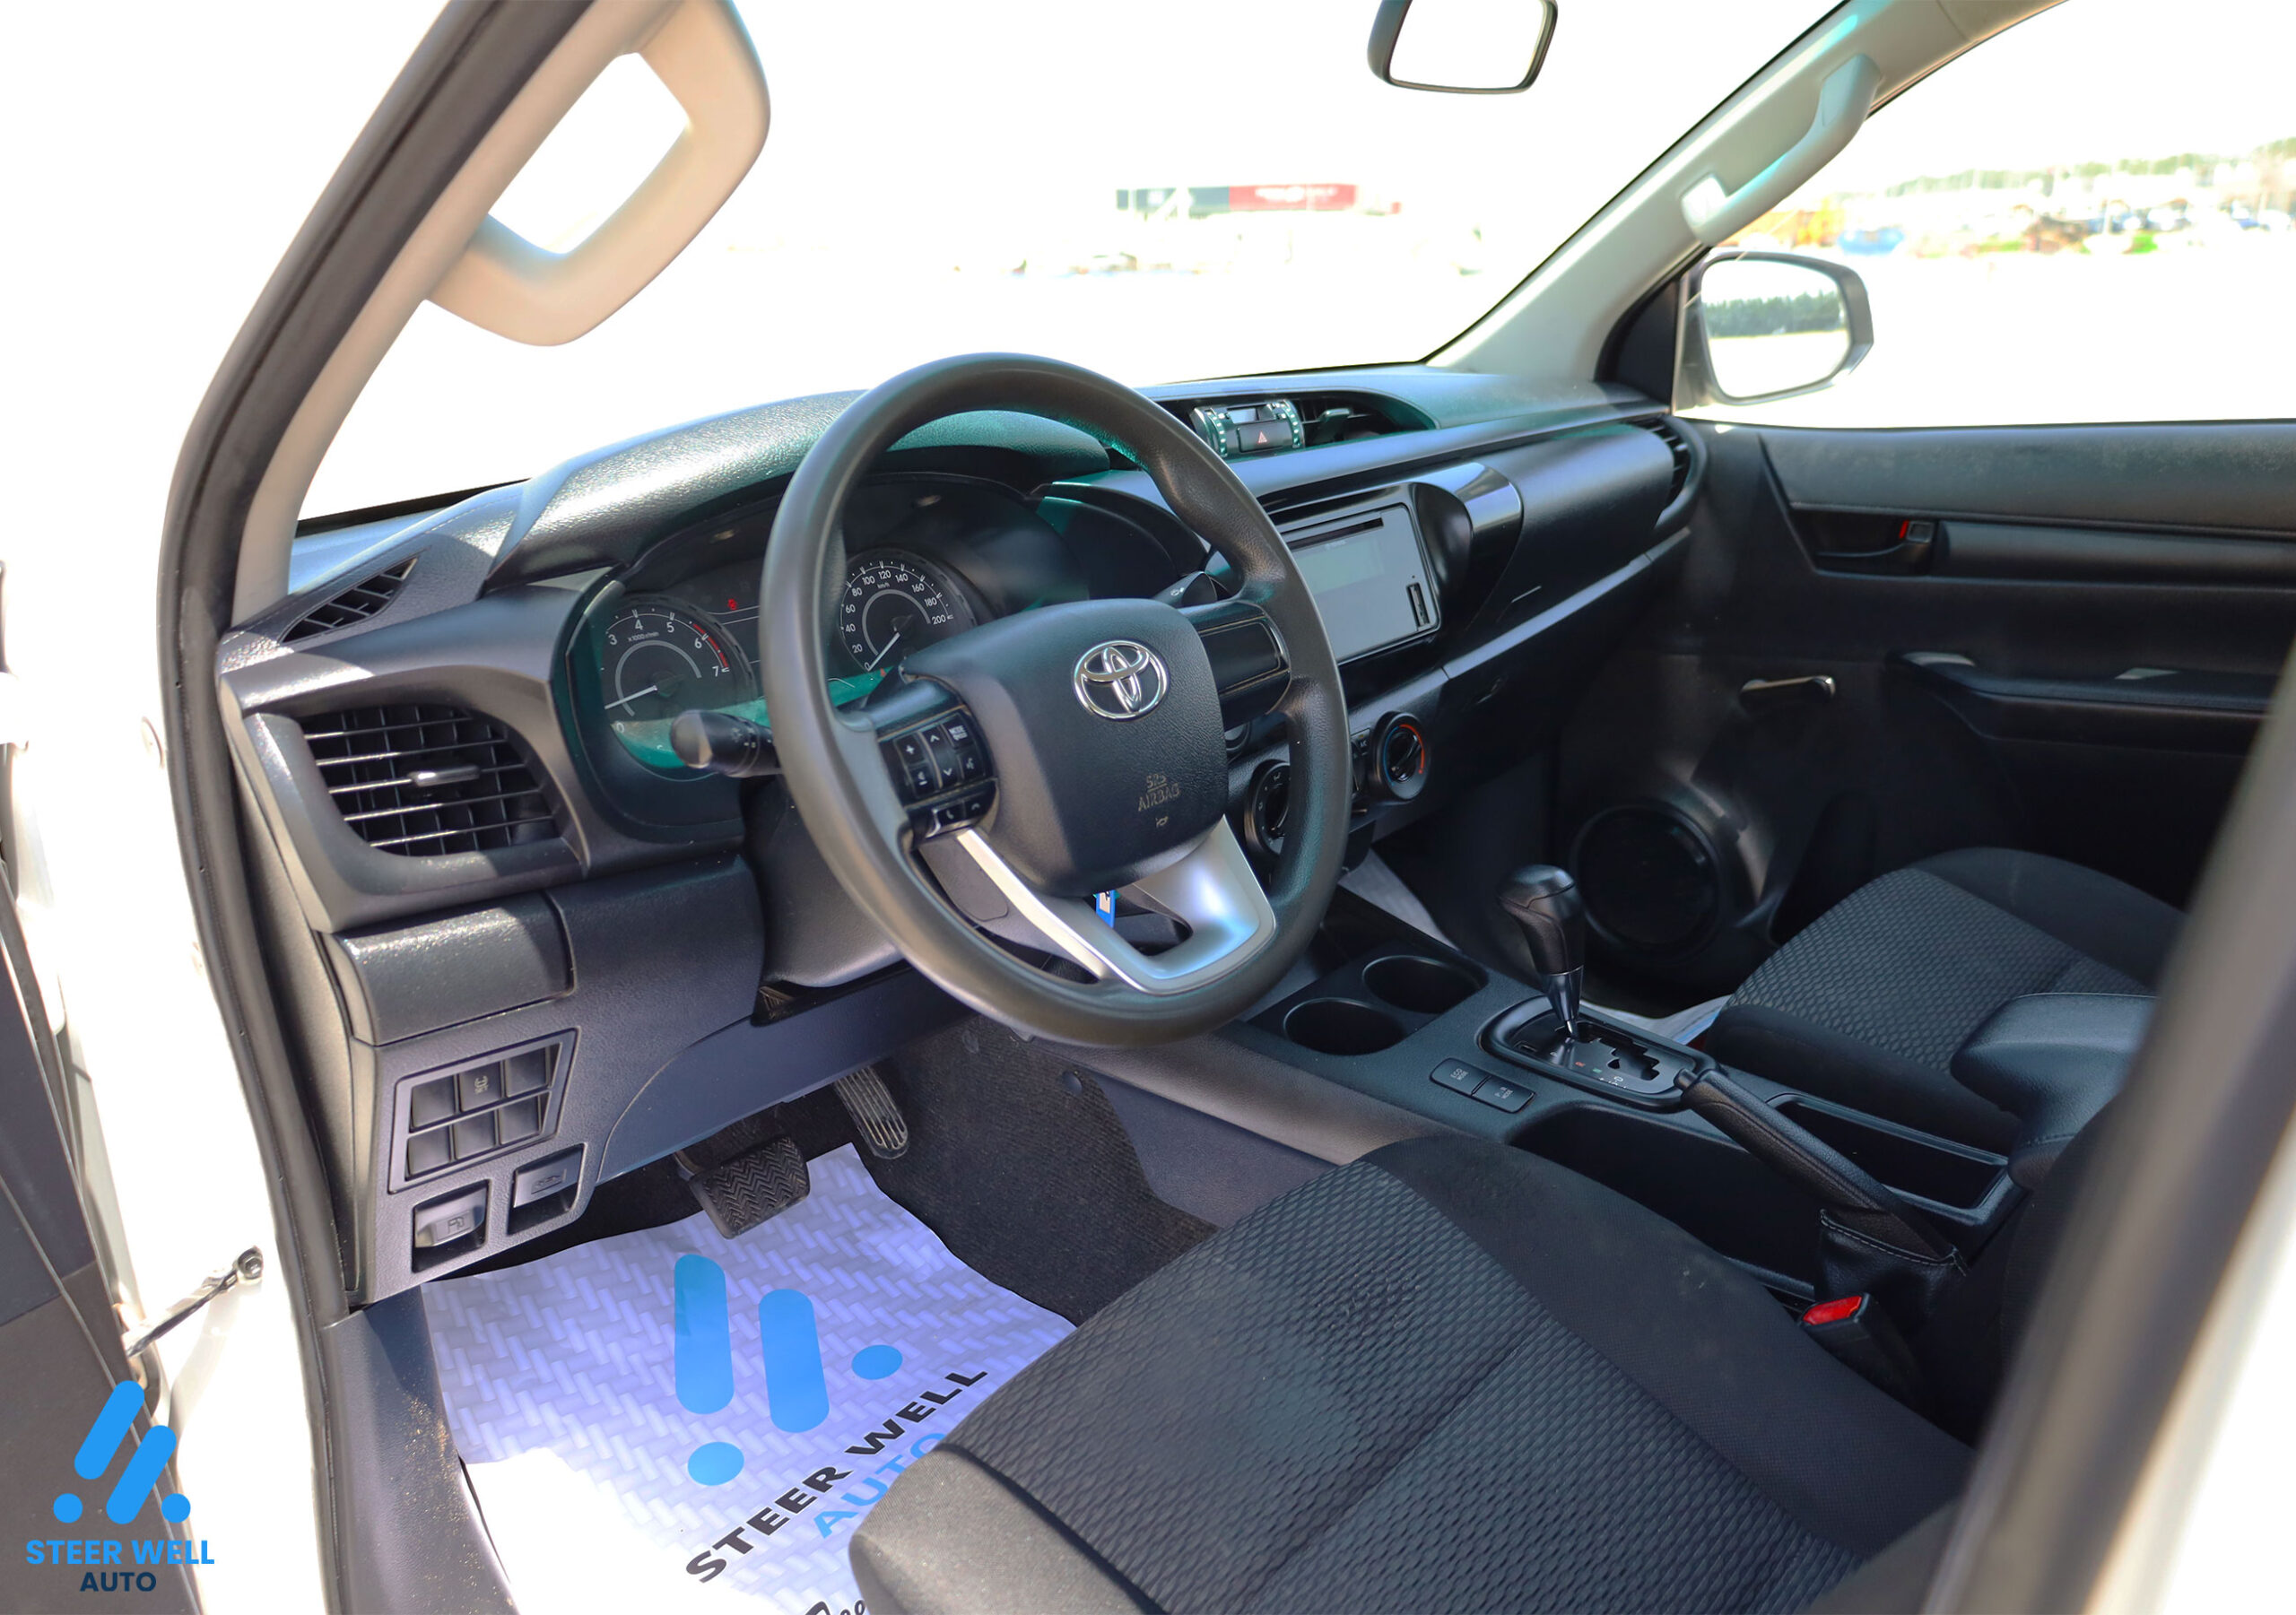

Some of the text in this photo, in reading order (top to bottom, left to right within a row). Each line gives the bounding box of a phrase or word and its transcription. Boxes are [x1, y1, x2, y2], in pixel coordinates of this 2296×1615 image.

[878, 569, 891, 580] 120
[895, 574, 909, 583] 140
[862, 576, 875, 586] 100
[851, 587, 863, 596] 80
[912, 583, 925, 593] 160
[924, 598, 937, 607] 180
[845, 604, 856, 613] 60
[932, 614, 946, 625] 200
[635, 620, 643, 630] 4
[666, 622, 674, 633] 5
[845, 623, 856, 633] 40
[608, 634, 618, 645] 3
[695, 638, 702, 648] 6
[852, 644, 863, 654] 20
[712, 665, 719, 677] 7
[864, 662, 871, 671] 0
[616, 723, 625, 733] 0
[685, 1371, 987, 1583] STEER WELL
